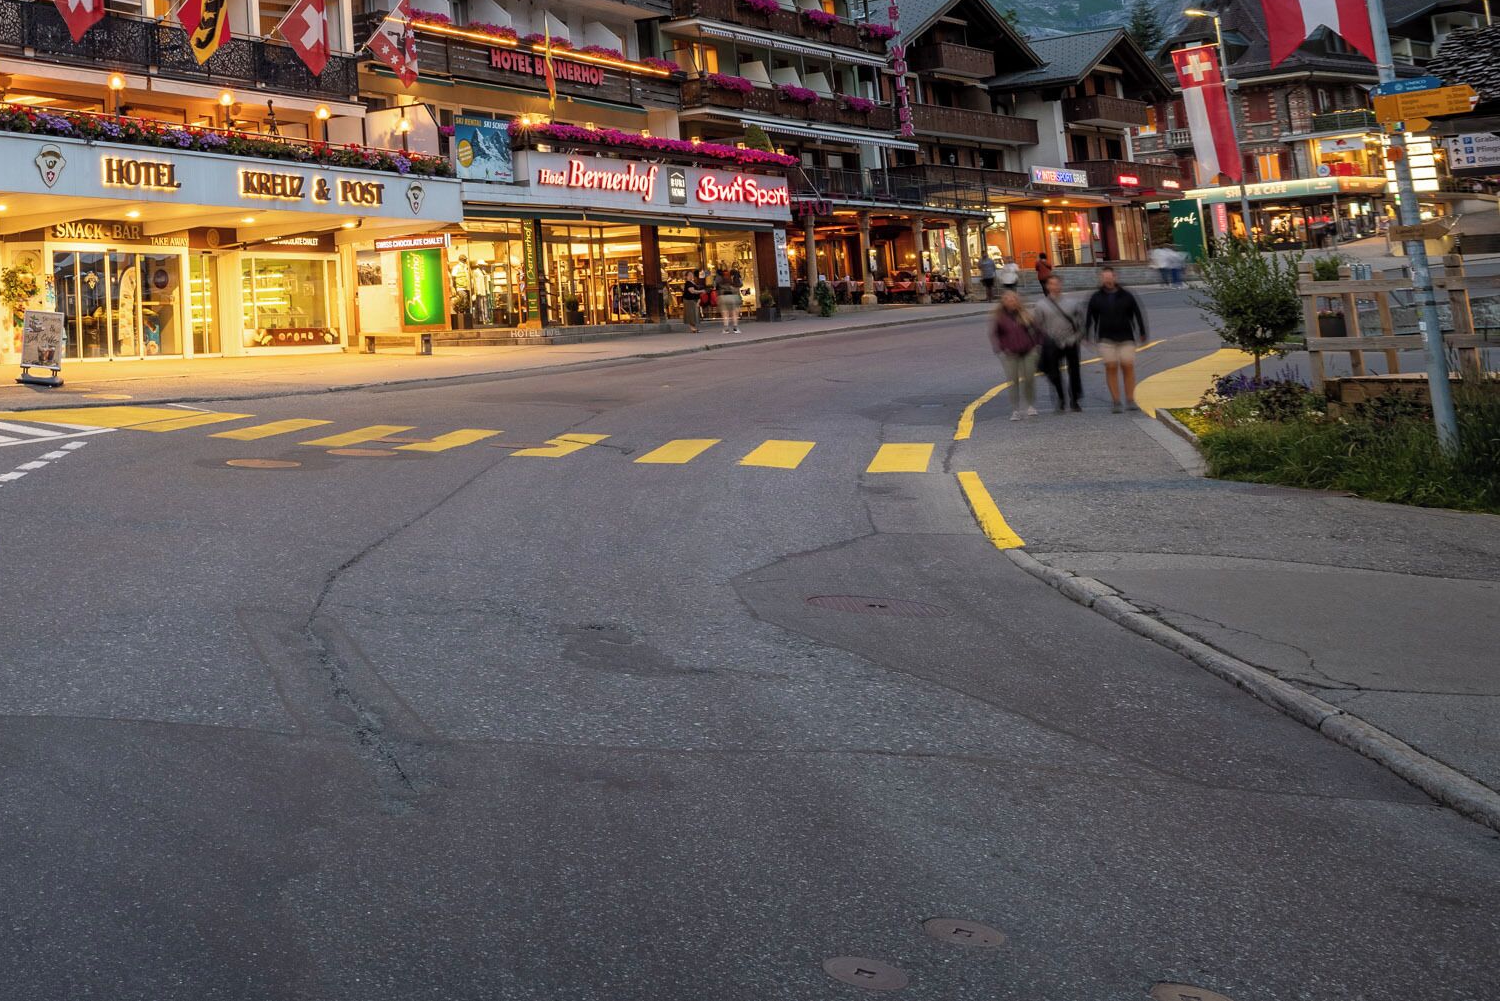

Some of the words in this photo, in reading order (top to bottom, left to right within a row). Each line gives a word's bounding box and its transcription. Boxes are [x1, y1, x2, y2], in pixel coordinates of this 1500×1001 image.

[490, 48, 532, 74] HOTEL
[892, 46, 914, 136] WOLTER
[455, 116, 464, 124] SKI
[483, 120, 491, 129] SKI
[492, 121, 509, 130] SCHOO
[104, 158, 182, 189] HOTEL
[539, 168, 567, 186] Hotel
[569, 160, 658, 202] Bernerhof
[1041, 170, 1073, 183] INTERSPORT
[1073, 173, 1087, 184] GRAF
[241, 171, 305, 199] KREUZ
[315, 178, 331, 201] &
[340, 180, 385, 205] POST
[744, 178, 789, 207] Sport
[1225, 187, 1252, 199] SHP
[55, 221, 102, 239] SNACK
[112, 224, 140, 240] BAR
[150, 236, 169, 246] TAKE
[170, 236, 189, 247] AWAY
[303, 237, 319, 246] CHALET
[393, 238, 423, 247] CHOCOLATE
[424, 236, 443, 245] CHALET
